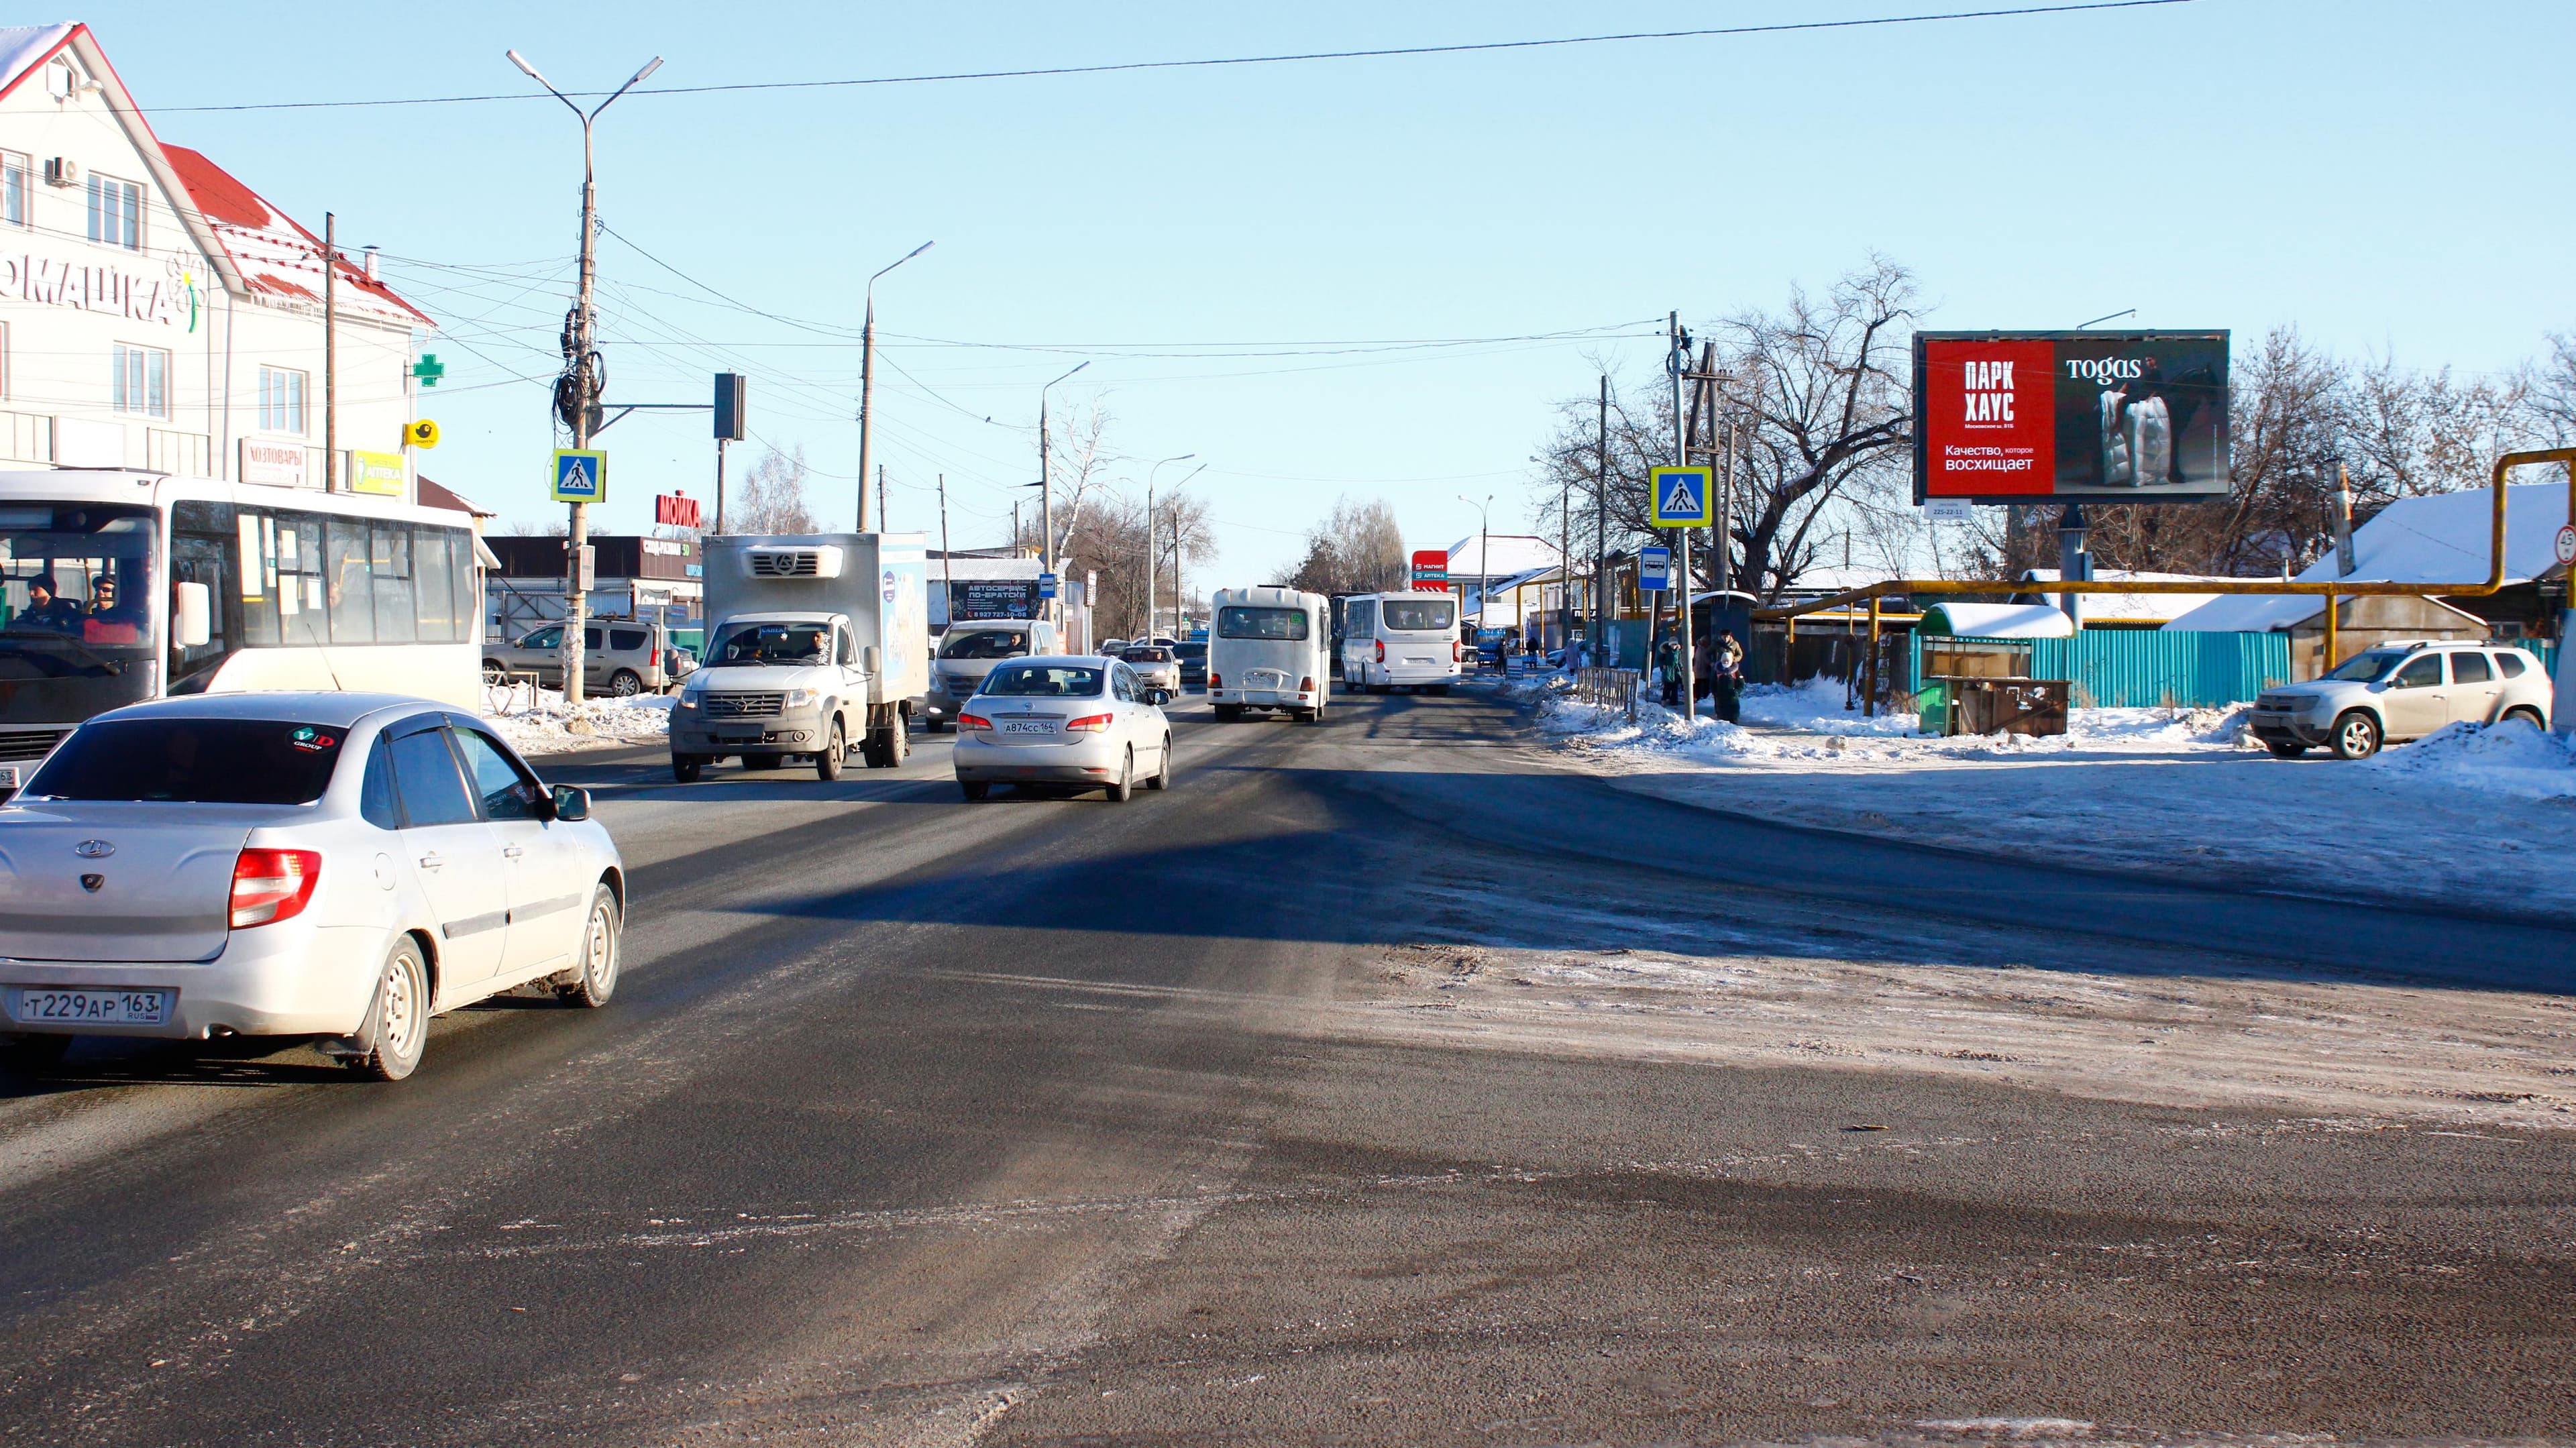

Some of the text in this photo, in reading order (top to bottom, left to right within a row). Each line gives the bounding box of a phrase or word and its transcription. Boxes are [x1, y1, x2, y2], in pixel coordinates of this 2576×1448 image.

[1965, 361, 2015, 390] ПАРК
[1965, 393, 2015, 421] ХАУС
[1945, 445, 2003, 457] Качество,
[1945, 459, 2034, 473] восхищает
[655, 490, 701, 528] МОЙКА
[1006, 723, 1038, 732] А874СС
[293, 740, 323, 750] GROUP
[30, 994, 156, 1018] Т229АР 163
